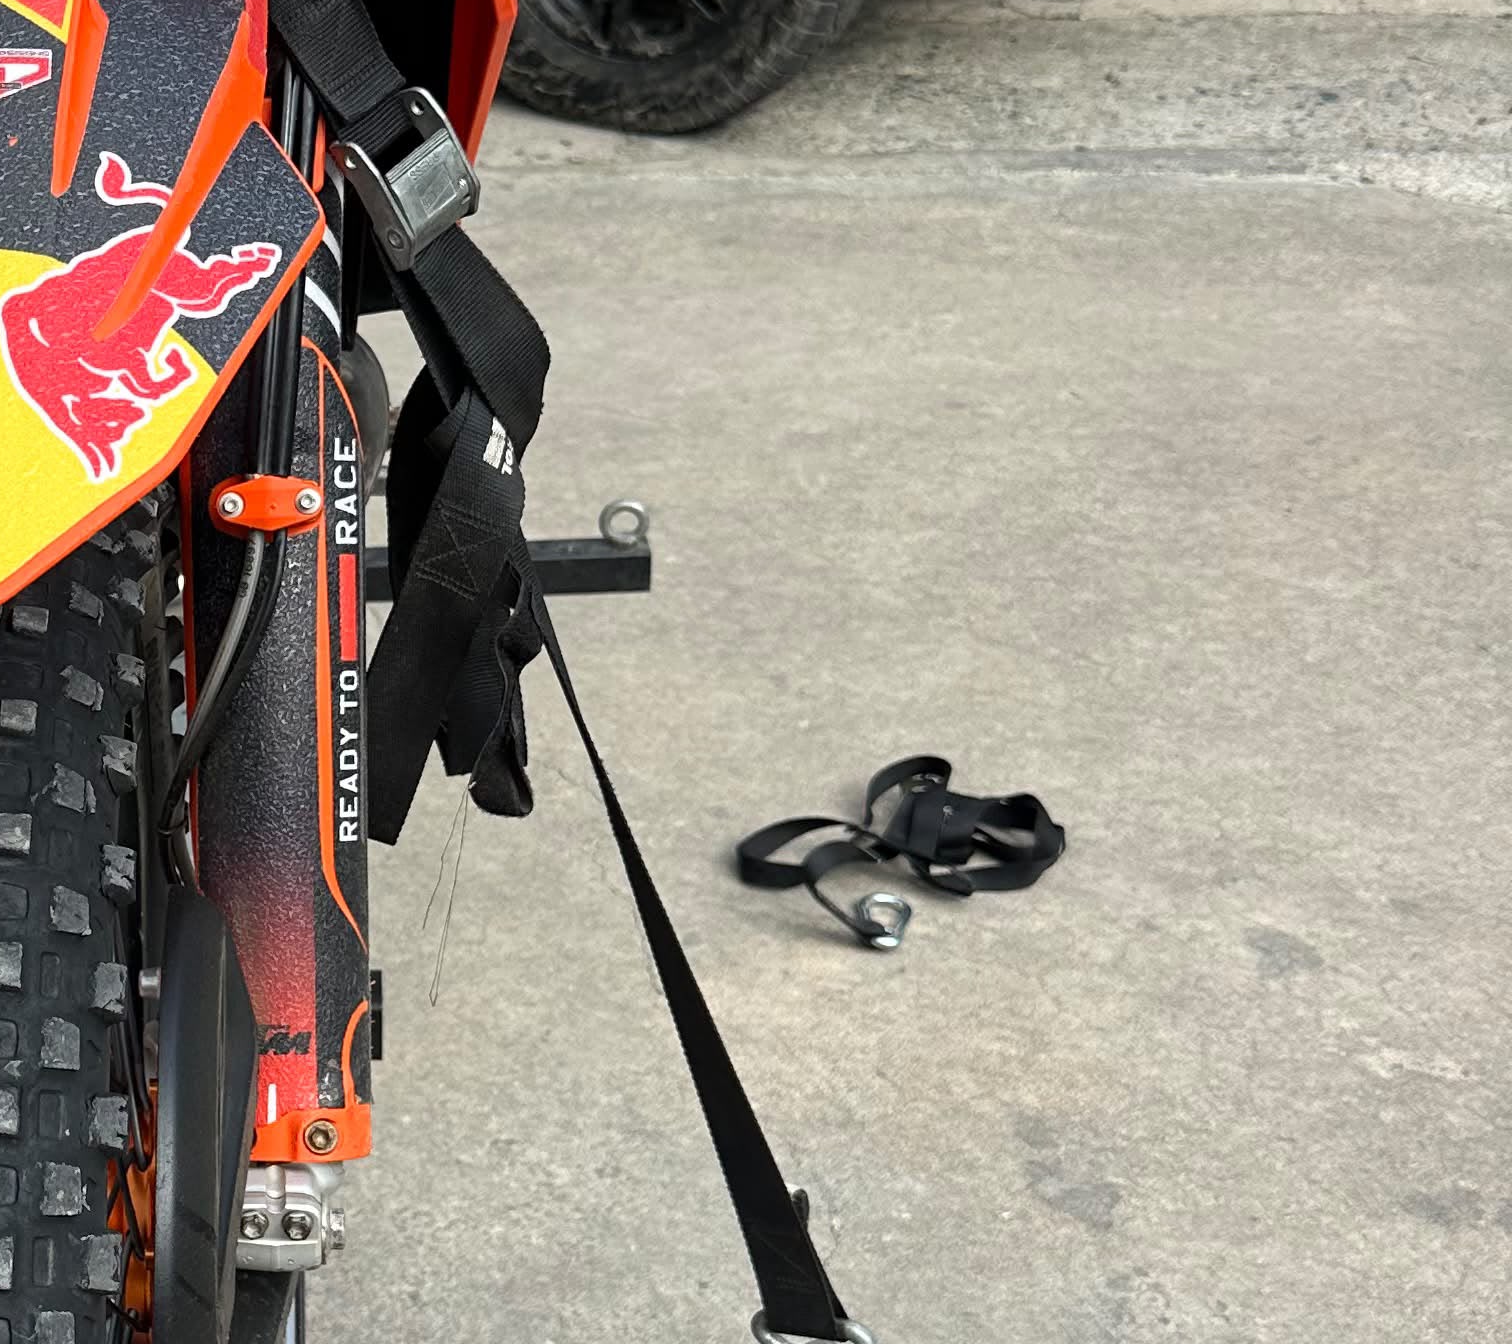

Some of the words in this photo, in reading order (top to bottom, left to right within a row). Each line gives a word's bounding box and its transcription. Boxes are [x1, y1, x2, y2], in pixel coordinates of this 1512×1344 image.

[334, 437, 358, 545] RACE
[339, 668, 359, 714] TO
[339, 727, 359, 842] READY
